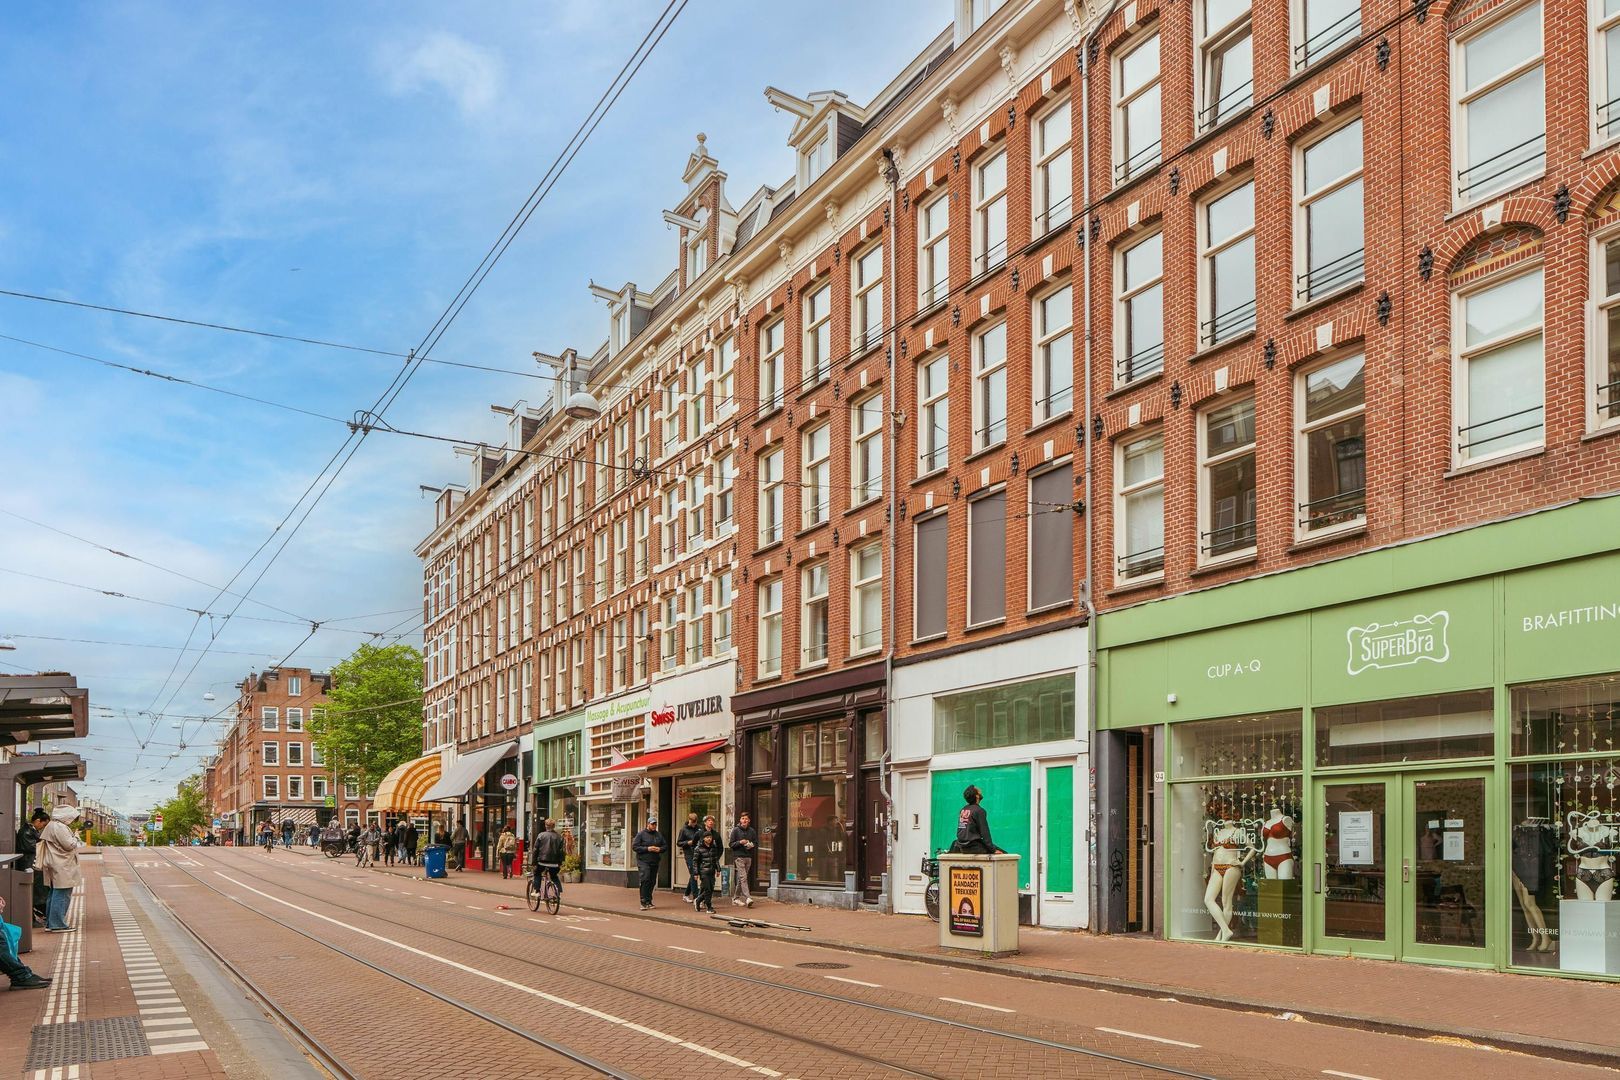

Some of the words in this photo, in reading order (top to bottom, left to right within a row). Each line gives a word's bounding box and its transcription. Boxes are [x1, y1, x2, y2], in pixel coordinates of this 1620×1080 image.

[1523, 603, 1620, 632] BRAFITTIN
[1207, 662, 1232, 679] CUP
[1234, 660, 1262, 675] A-Q
[676, 694, 723, 721] JUWELIER
[587, 708, 609, 722] Massage
[1155, 773, 1164, 781] 94
[954, 880, 979, 888] AANDACHT
[1527, 927, 1559, 935] LINGERIE
